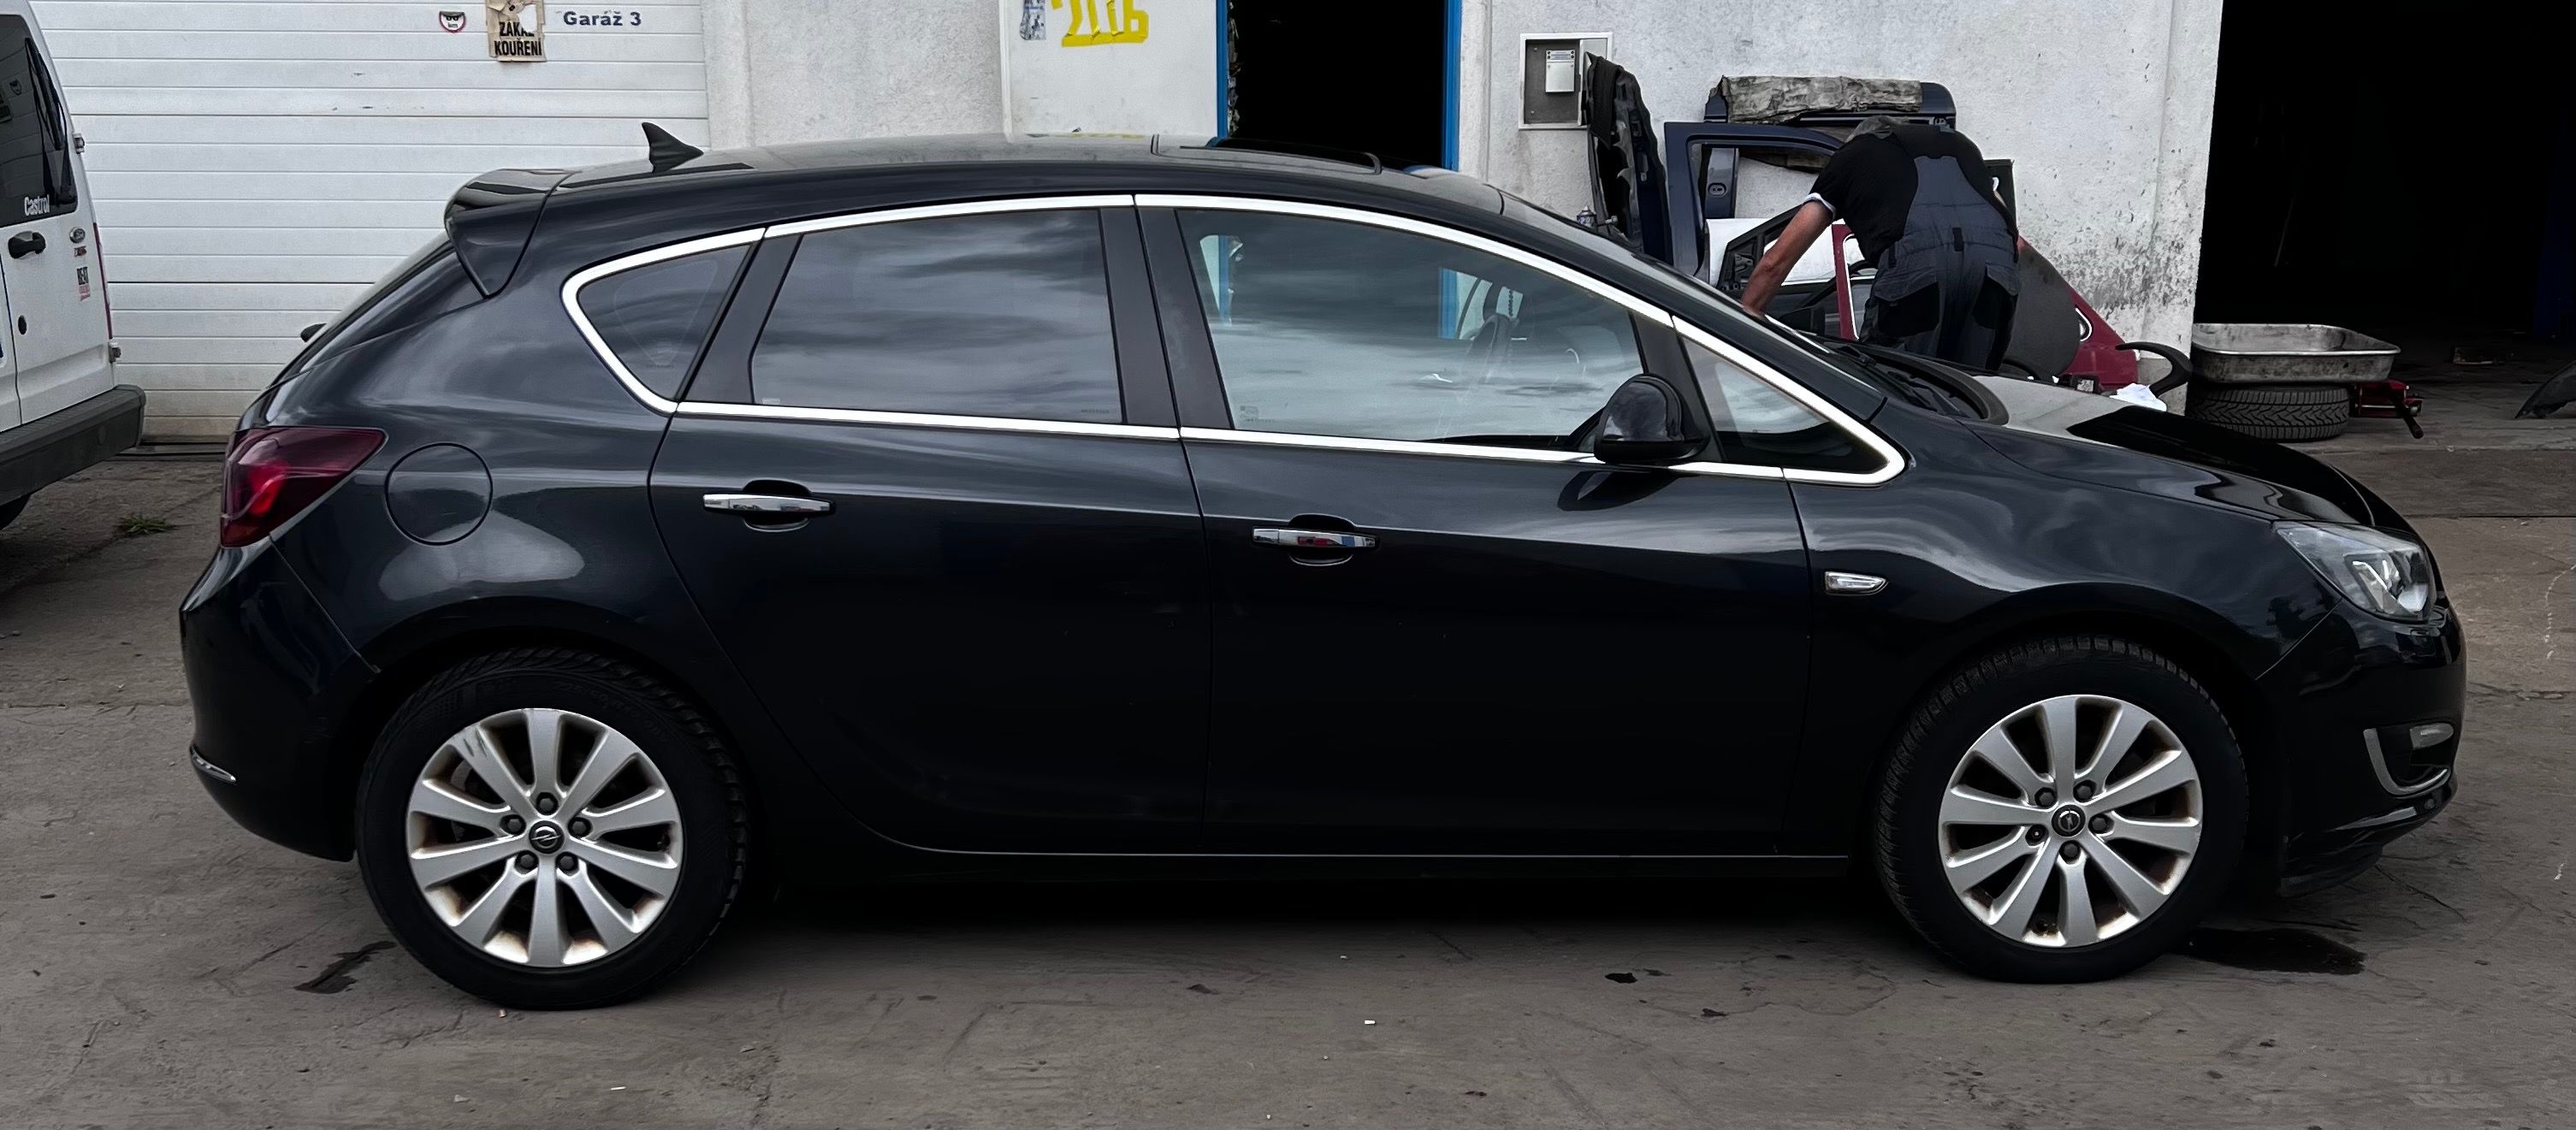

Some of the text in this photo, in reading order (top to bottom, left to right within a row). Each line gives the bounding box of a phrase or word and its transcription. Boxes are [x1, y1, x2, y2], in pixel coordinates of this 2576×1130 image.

[563, 9, 642, 27] Garáž 3
[494, 38, 542, 56] KOUŘENÍ
[24, 193, 50, 216] Castrol
